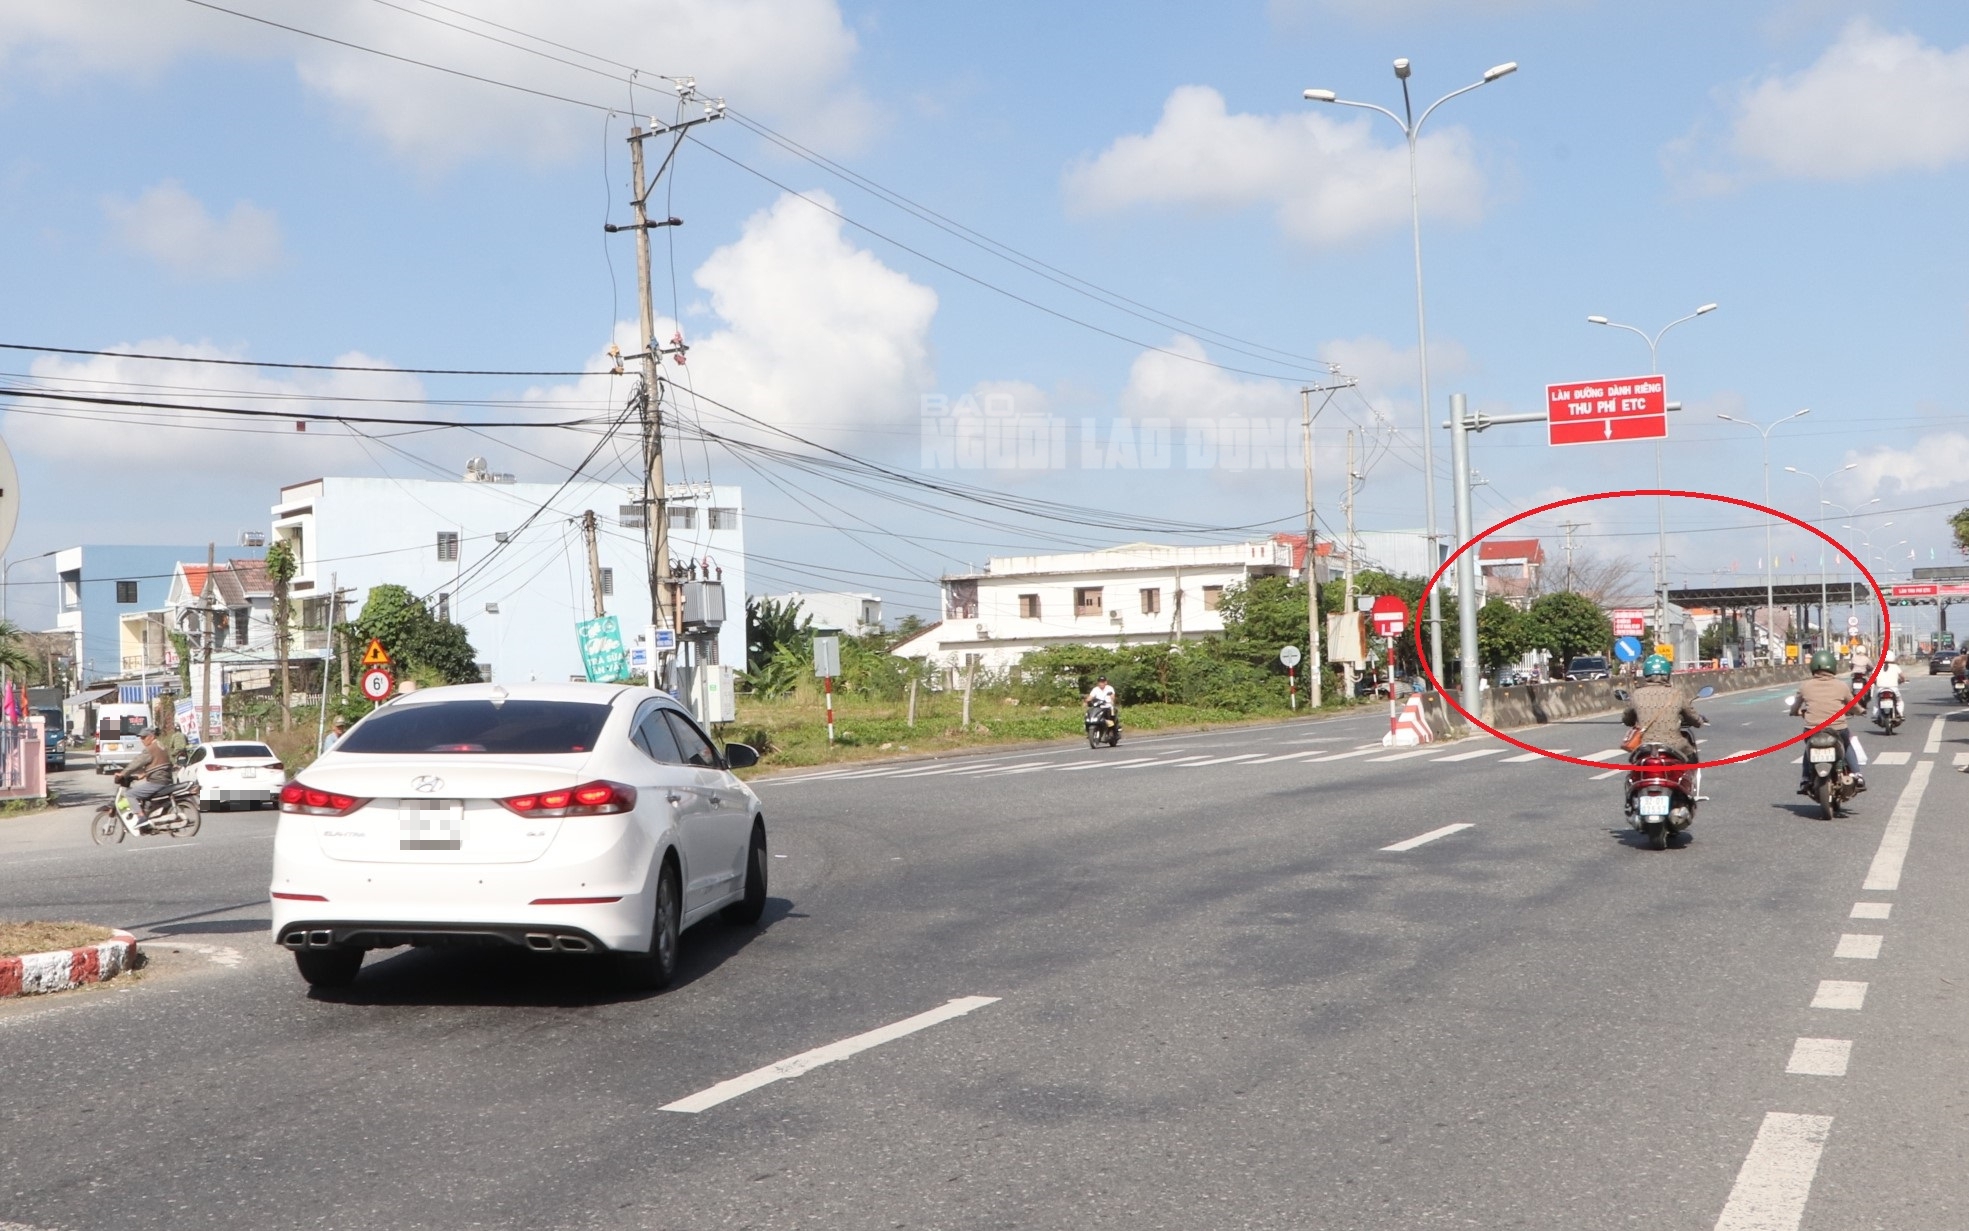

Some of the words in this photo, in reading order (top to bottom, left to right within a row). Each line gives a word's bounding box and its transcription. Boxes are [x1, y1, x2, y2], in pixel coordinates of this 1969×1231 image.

[1552, 389, 1570, 401] LÀN
[1574, 386, 1604, 399] ĐƯỜNG
[1608, 384, 1632, 397] DÀNH
[1634, 382, 1662, 394] RIÊNG
[1568, 402, 1592, 415] THU
[1597, 398, 1616, 413] PHÍ
[1622, 398, 1646, 411] ETC
